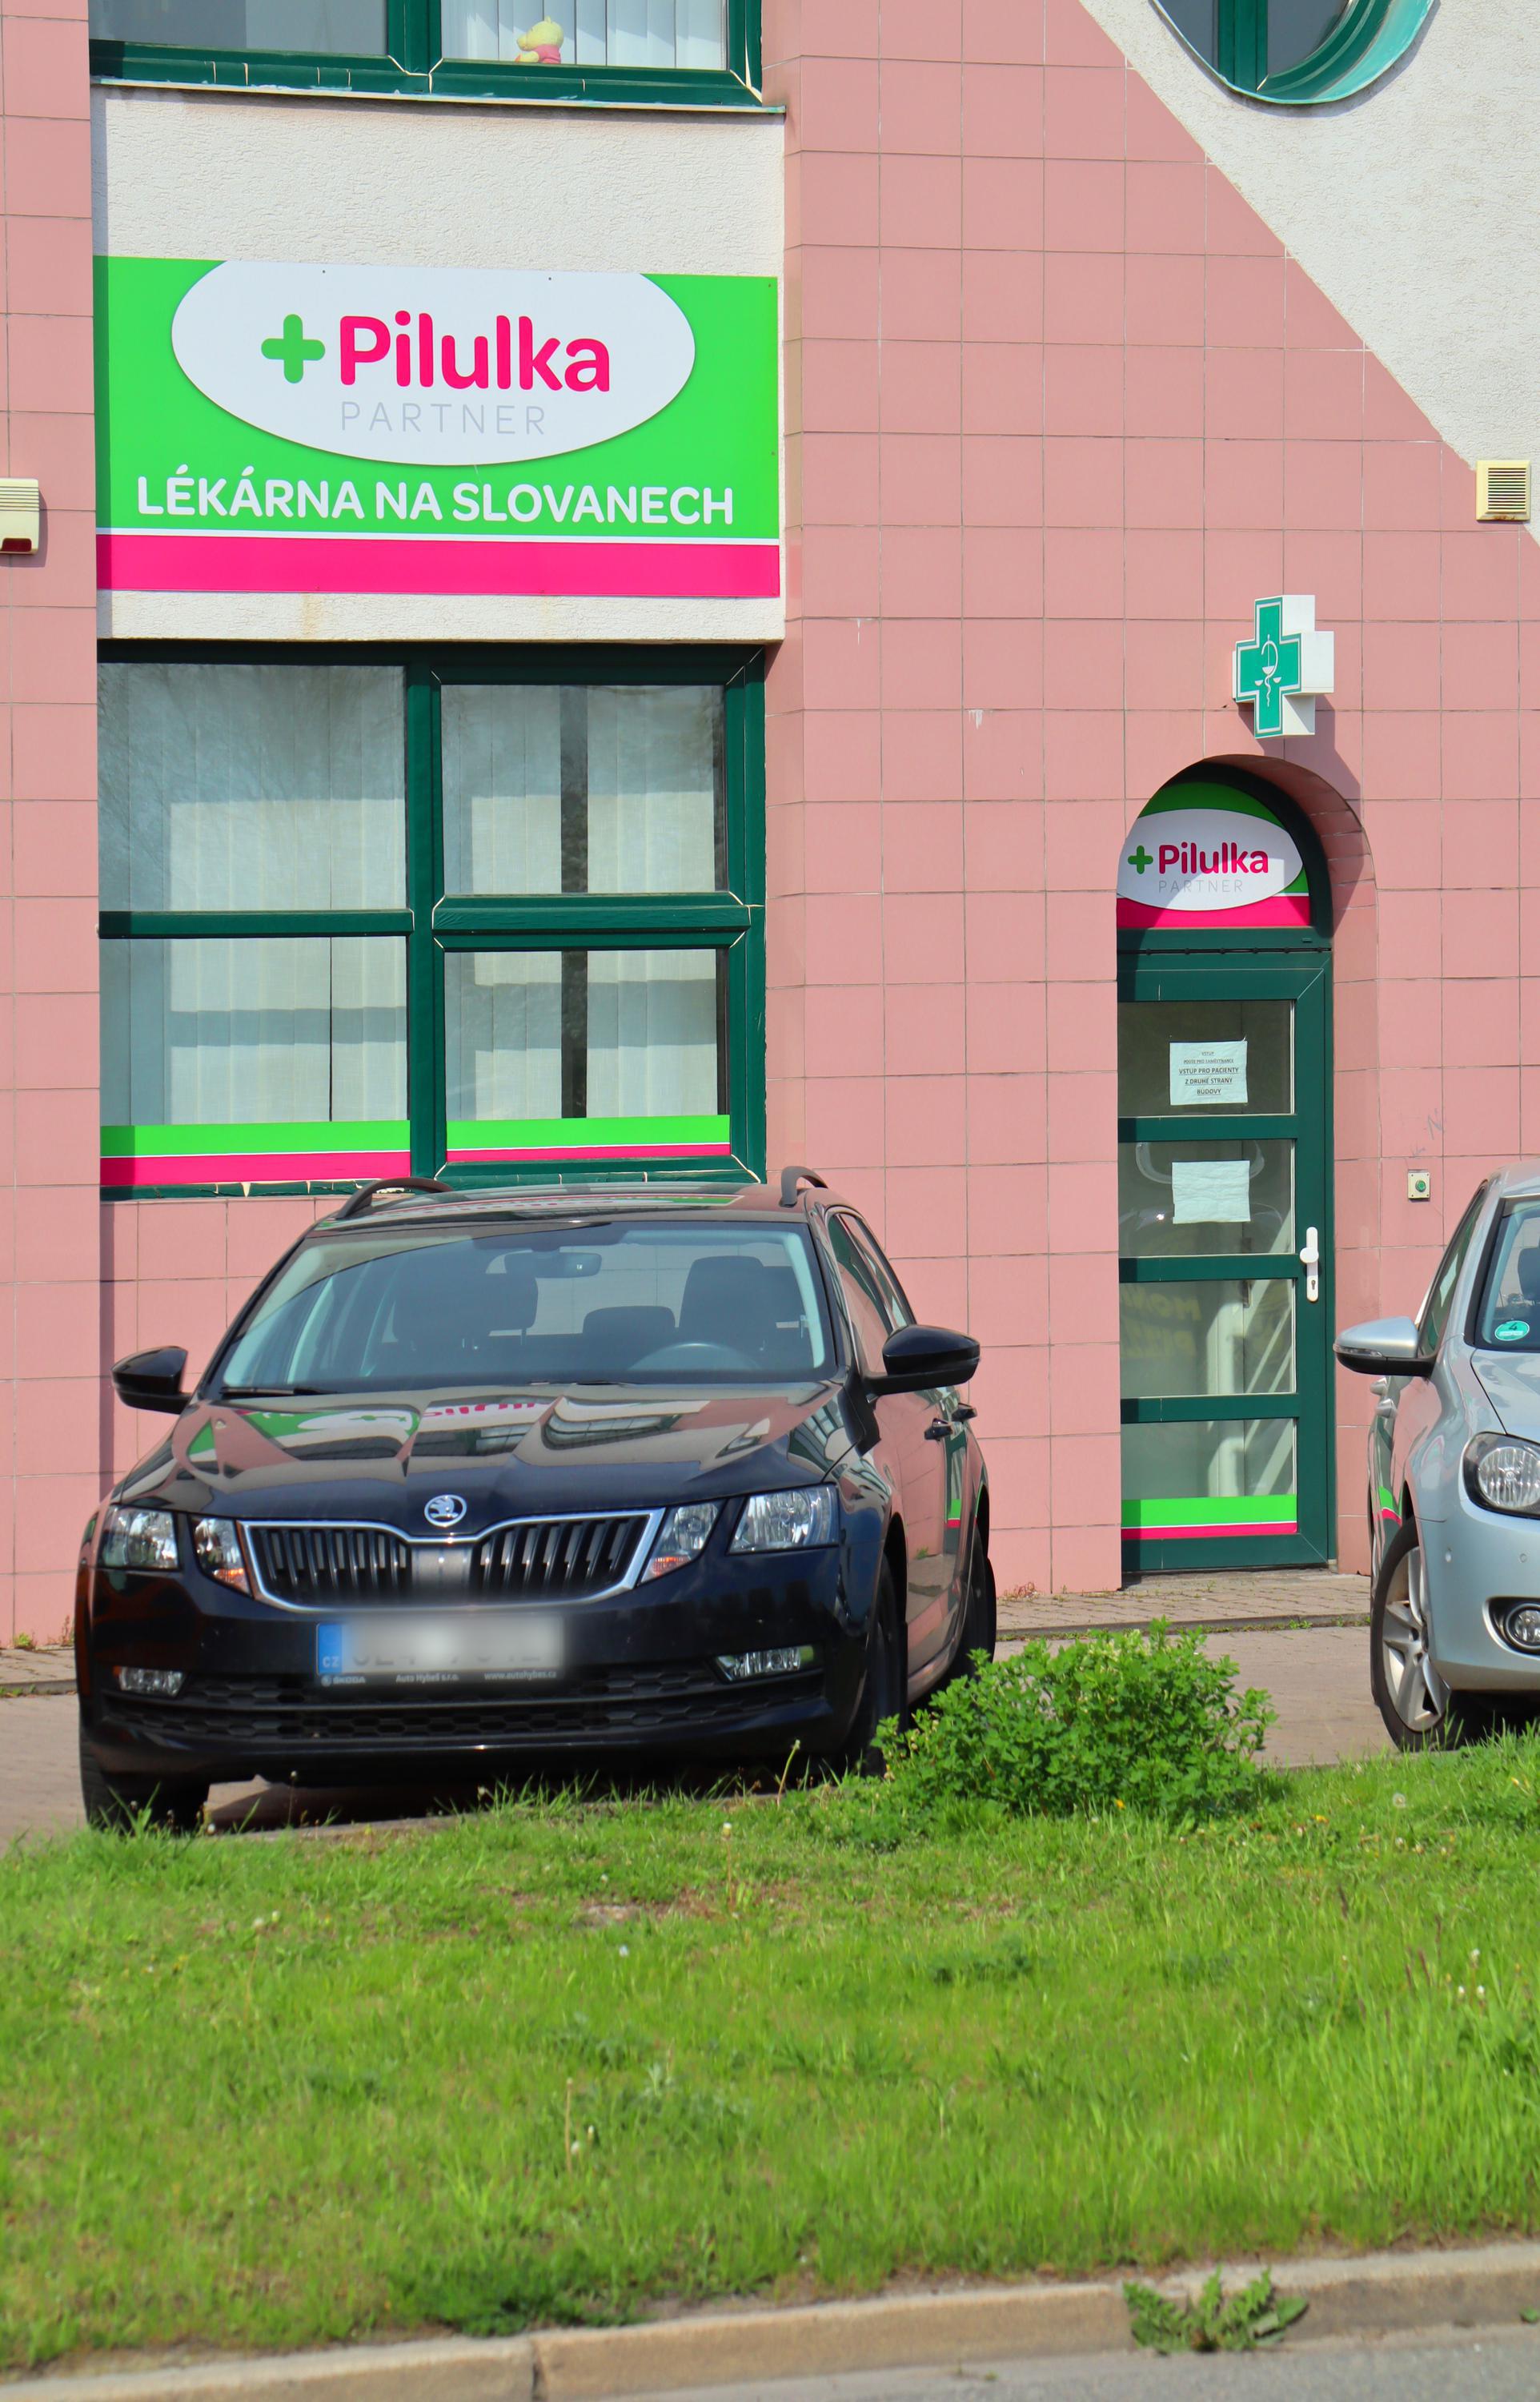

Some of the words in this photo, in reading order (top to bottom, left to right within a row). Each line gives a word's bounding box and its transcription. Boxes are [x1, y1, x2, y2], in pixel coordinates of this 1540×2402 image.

[340, 310, 610, 393] Pilulka
[342, 401, 545, 435] PARTNER
[138, 464, 364, 519] LÉKÁRNA
[375, 482, 443, 521] NA
[453, 484, 733, 525] SLOVANECH
[1158, 842, 1269, 874] Pilulka
[1158, 879, 1243, 893] PARTNER
[1509, 1322, 1518, 1331] 4
[322, 1656, 340, 1668] CZ
